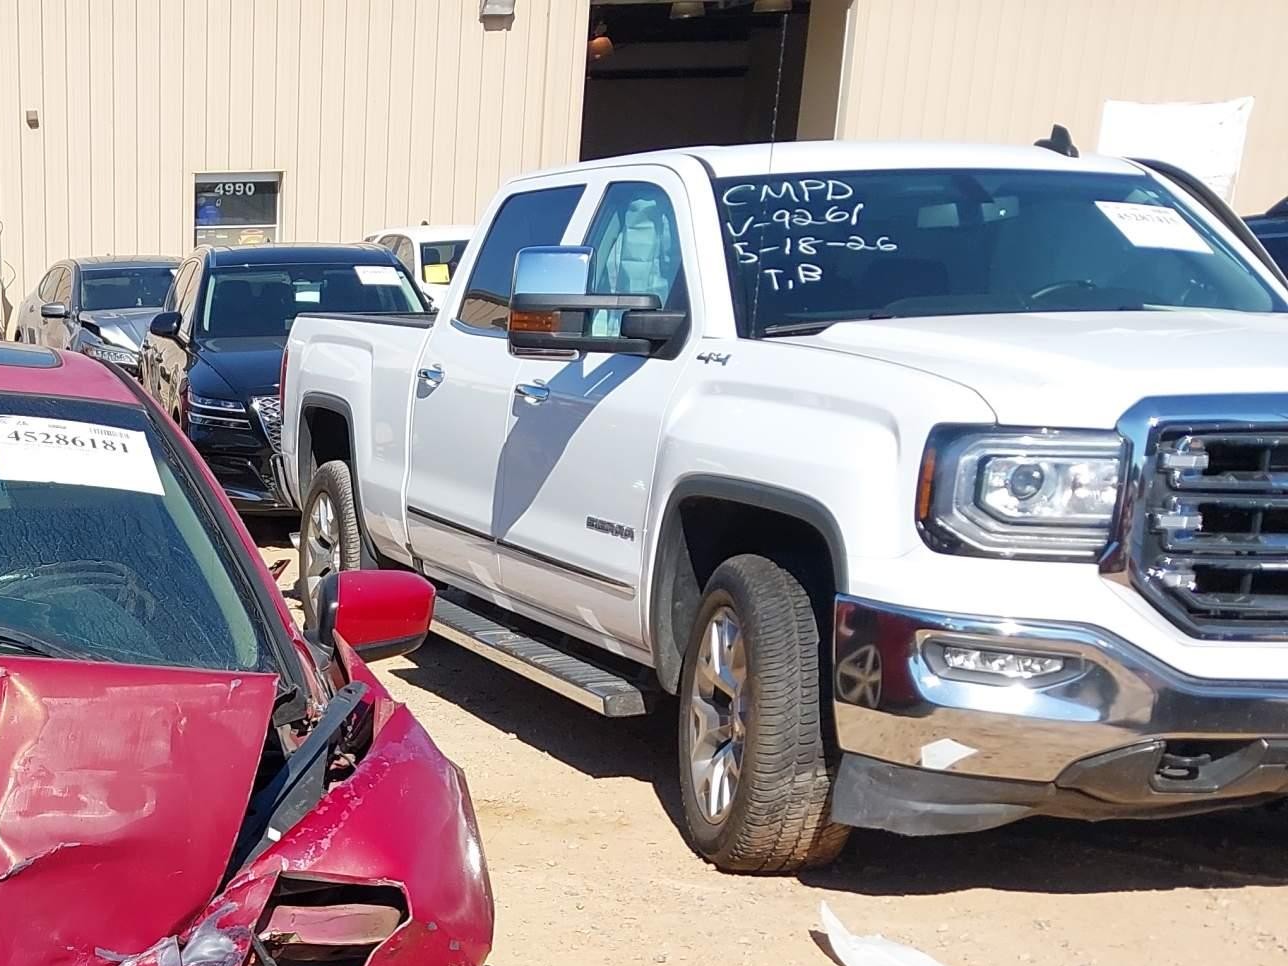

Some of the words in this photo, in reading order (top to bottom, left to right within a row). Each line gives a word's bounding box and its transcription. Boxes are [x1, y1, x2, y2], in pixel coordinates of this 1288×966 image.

[215, 183, 255, 196] 4990
[722, 179, 854, 206] CMPD
[726, 203, 864, 236] V-9261
[733, 235, 898, 264] 5-18-26
[6, 429, 129, 454] 45286181
